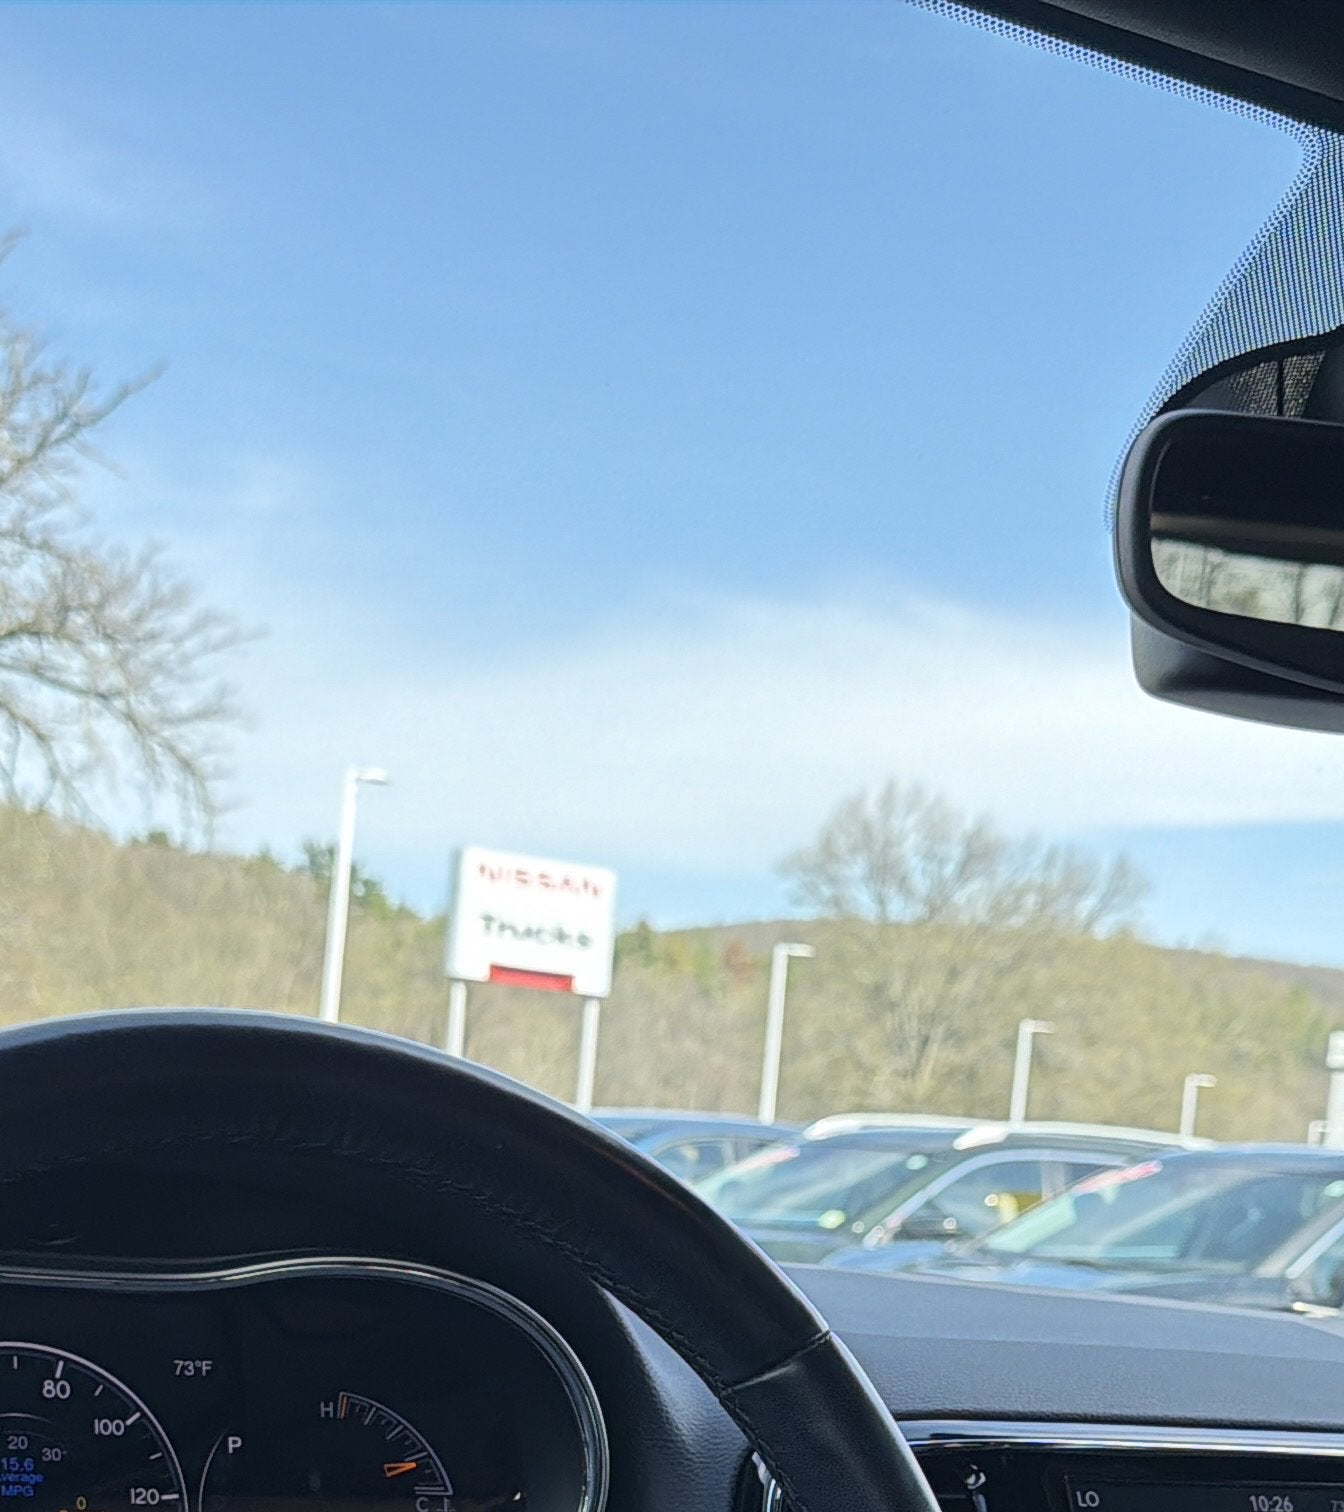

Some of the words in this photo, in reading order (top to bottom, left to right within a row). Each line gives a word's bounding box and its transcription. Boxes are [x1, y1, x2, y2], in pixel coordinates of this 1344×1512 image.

[478, 863, 602, 897] NISSAN
[479, 913, 594, 948] Trucks
[173, 1359, 213, 1376] 73°F
[42, 1379, 71, 1400] 80
[320, 1401, 334, 1418] H
[94, 1418, 125, 1436] 100
[8, 1436, 28, 1450] 20
[227, 1436, 242, 1453] P
[1, 1457, 34, 1471] 15.6
[1, 1485, 34, 1498] MPG
[130, 1488, 160, 1505] 120
[1076, 1491, 1100, 1507] LO
[76, 1496, 87, 1510] 0
[415, 1497, 428, 1512] C
[1249, 1496, 1294, 1512] 10:26
